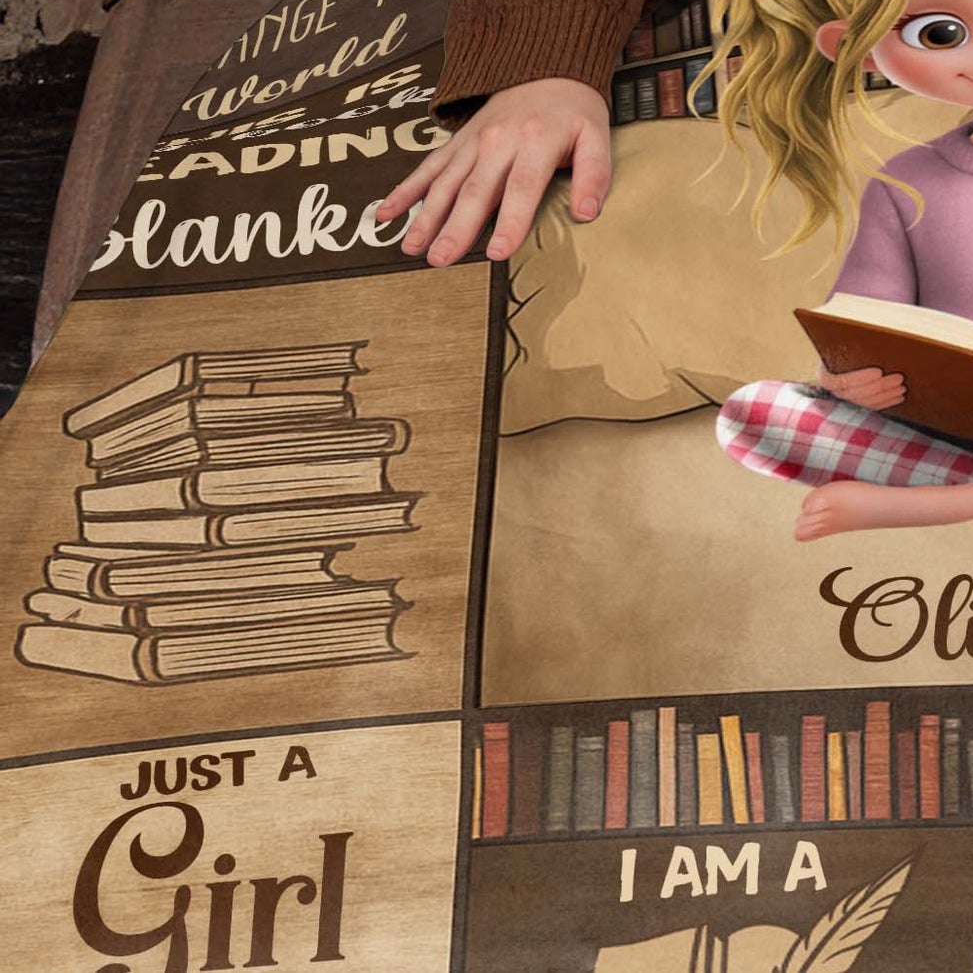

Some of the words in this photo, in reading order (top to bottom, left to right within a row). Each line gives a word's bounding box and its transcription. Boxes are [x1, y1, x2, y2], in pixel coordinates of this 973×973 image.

[181, 13, 409, 121] World
[344, 63, 422, 104] IS
[137, 116, 450, 182] EADING
[89, 183, 428, 272] lanke
[120, 749, 256, 800] JUST
[278, 745, 317, 782] A
[73, 801, 354, 973] Girl
[619, 848, 637, 903] I
[660, 842, 760, 898] AM
[784, 840, 827, 892] A
